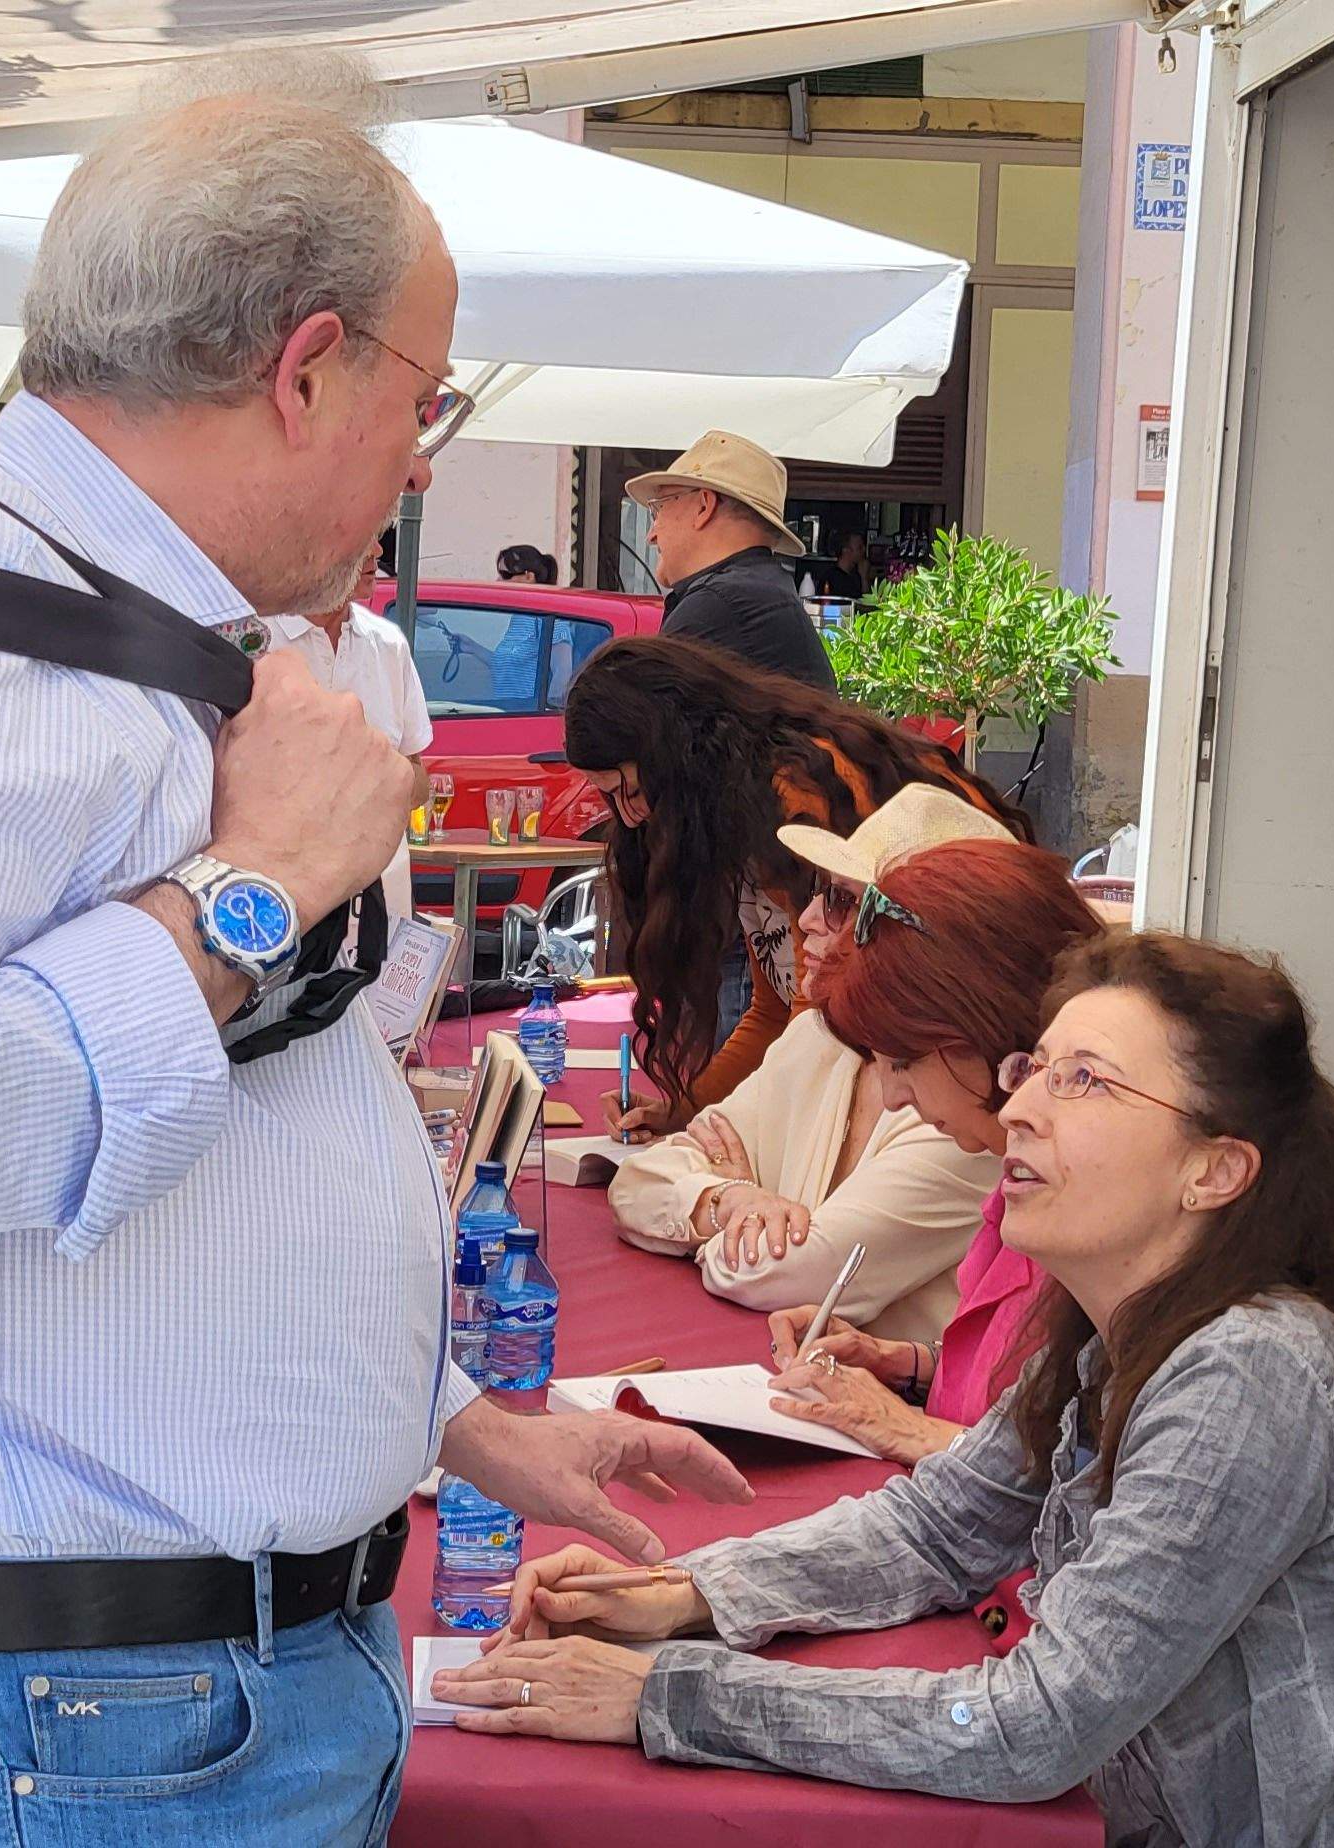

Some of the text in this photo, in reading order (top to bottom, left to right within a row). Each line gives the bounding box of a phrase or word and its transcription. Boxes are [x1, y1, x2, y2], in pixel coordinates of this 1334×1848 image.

[1172, 179, 1186, 197] D
[1141, 200, 1187, 219] LOPE
[57, 1701, 101, 1716] MK
